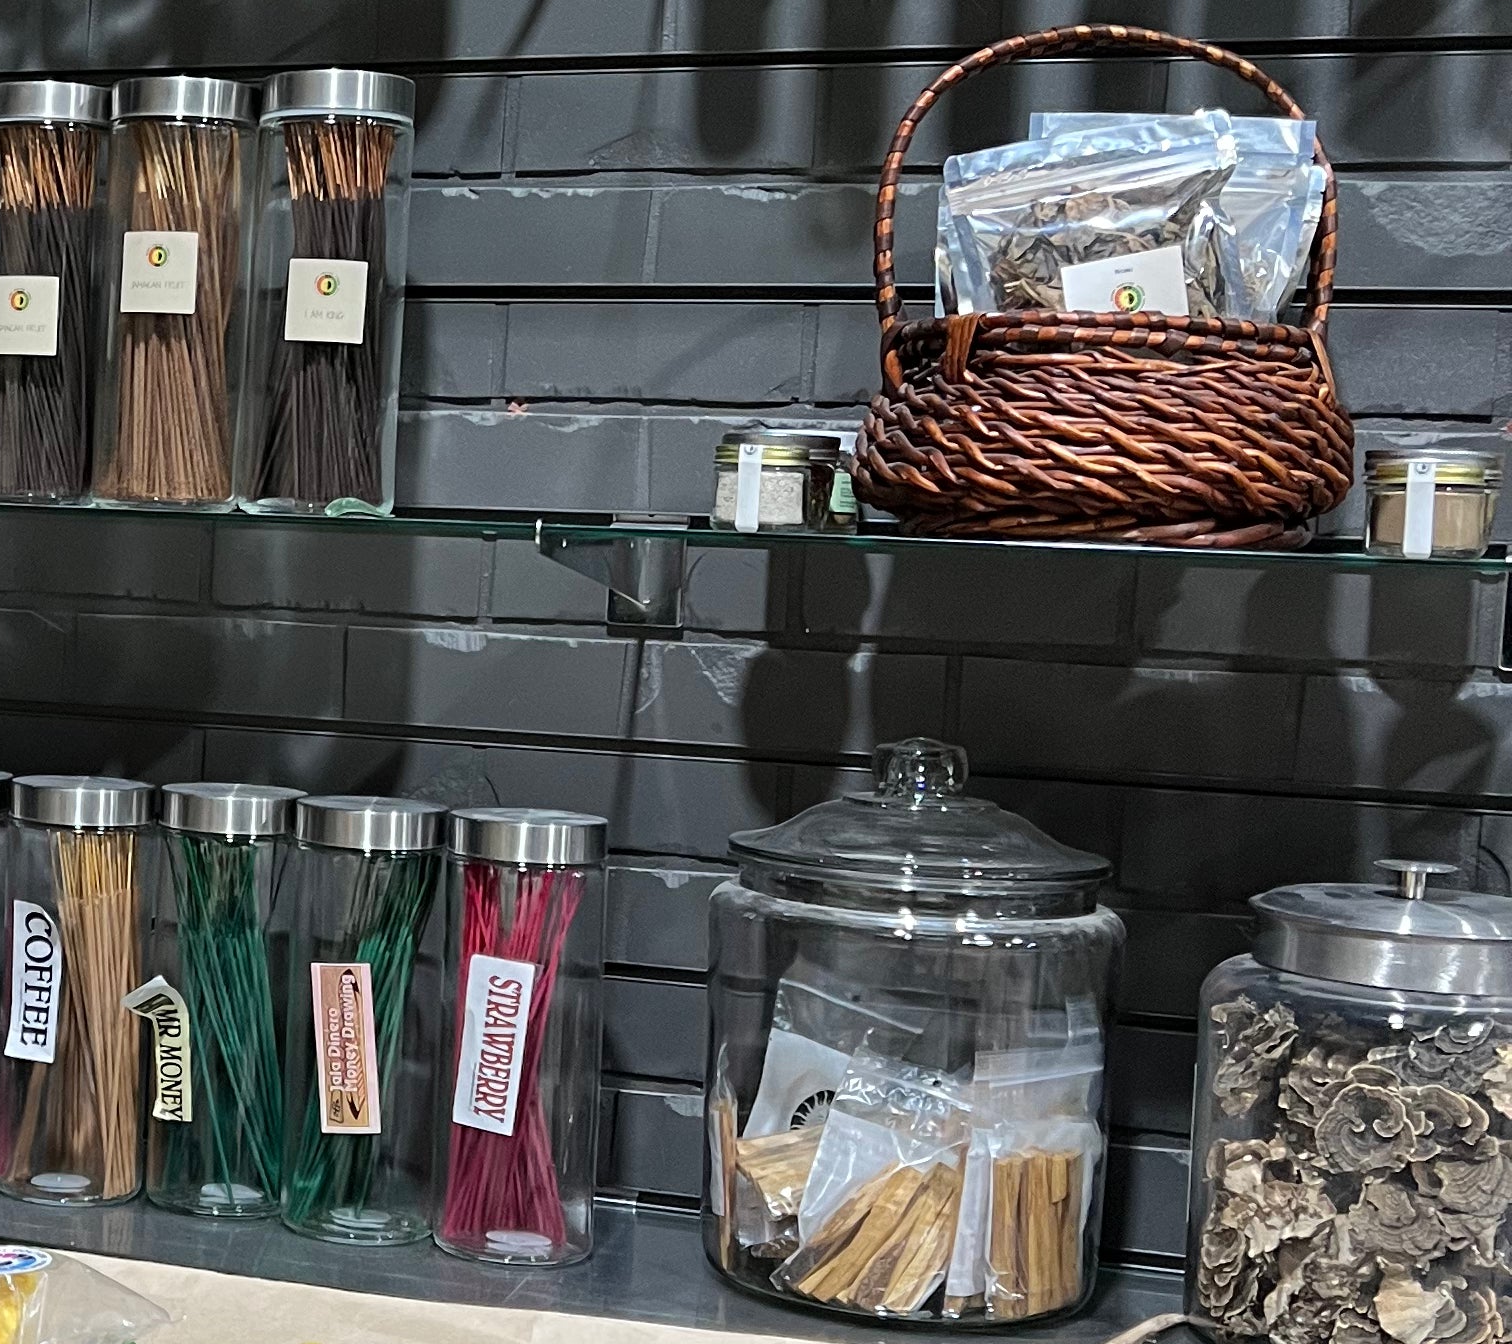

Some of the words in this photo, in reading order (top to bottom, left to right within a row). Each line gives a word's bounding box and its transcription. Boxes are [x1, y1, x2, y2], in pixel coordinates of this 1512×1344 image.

[19, 912, 54, 1047] COFFEE
[338, 973, 357, 1039] Drawing
[324, 1006, 342, 1058] Dinero
[474, 974, 523, 1124] STRAWBERRY
[159, 1043, 185, 1121] MONEY
[327, 1061, 344, 1092] Jala
[340, 1043, 360, 1092] Money
